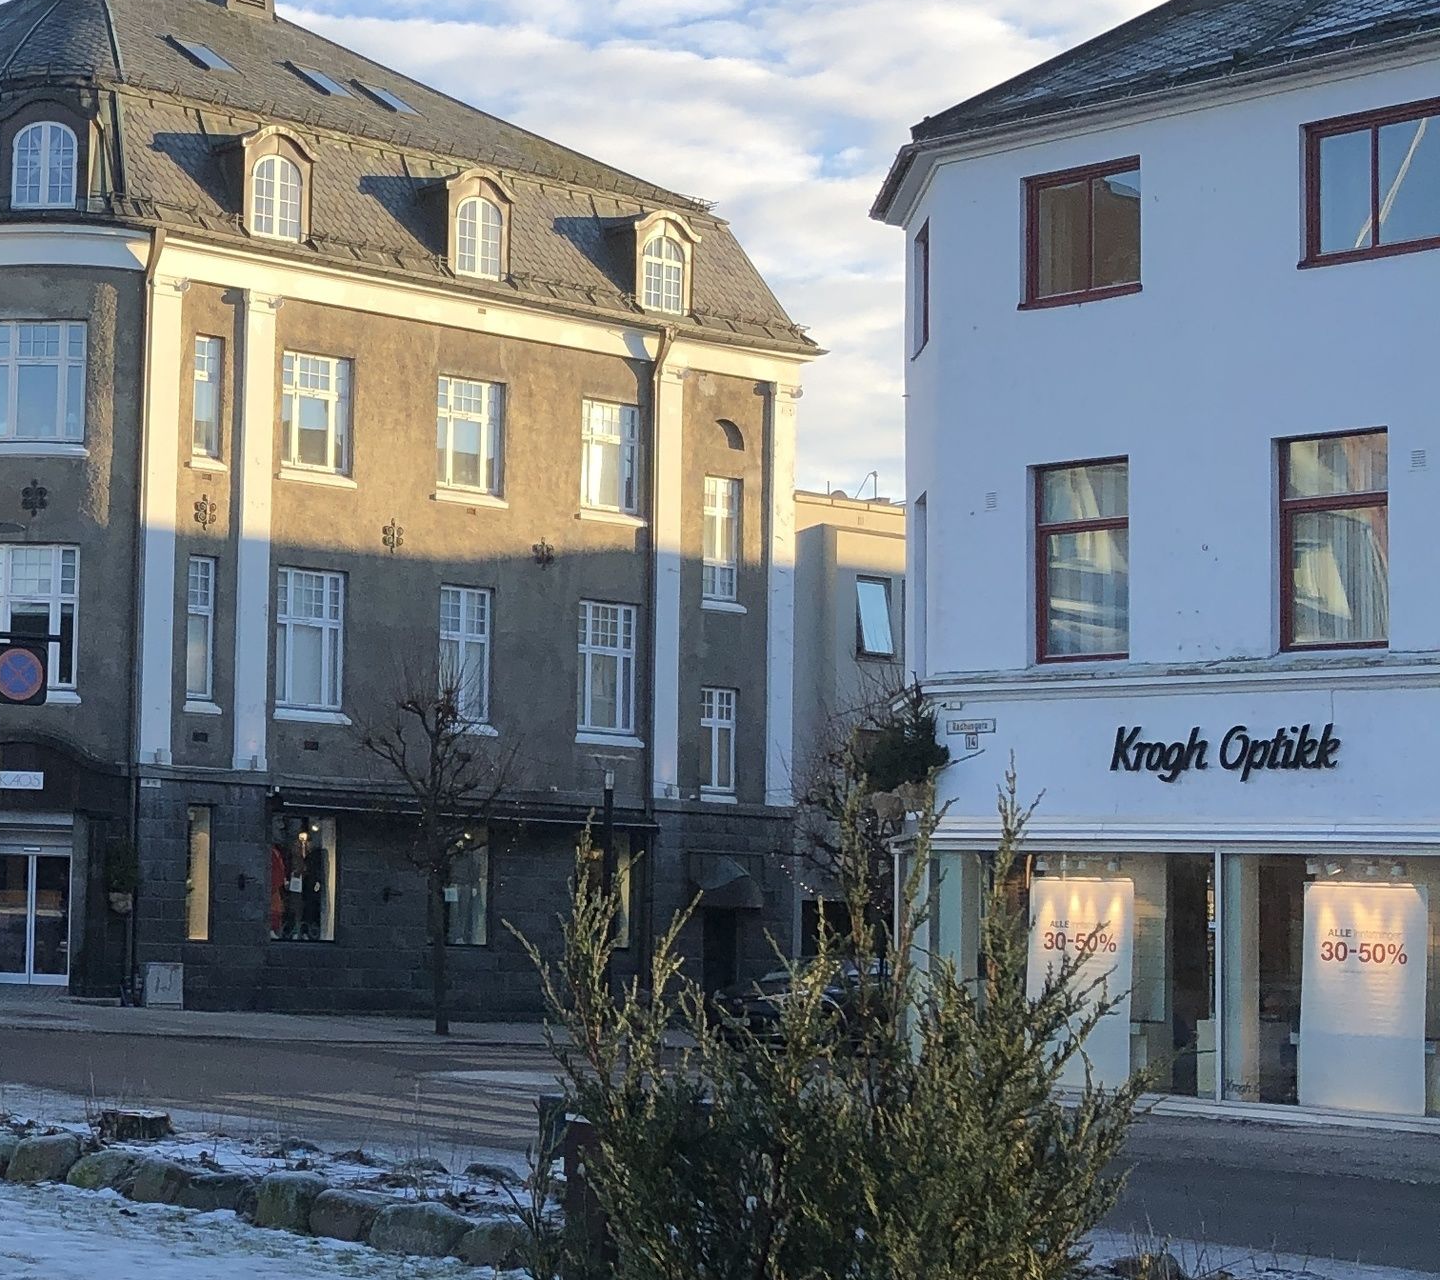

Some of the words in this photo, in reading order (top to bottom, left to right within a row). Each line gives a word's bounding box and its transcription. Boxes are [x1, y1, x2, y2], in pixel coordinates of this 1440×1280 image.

[1109, 726, 1209, 783] Krogh
[1219, 723, 1341, 783] Optikk
[0, 773, 41, 786] KAOS
[1043, 931, 1117, 953] 30-50%
[1328, 928, 1352, 938] ALLE
[1320, 941, 1408, 965] 30-50%
